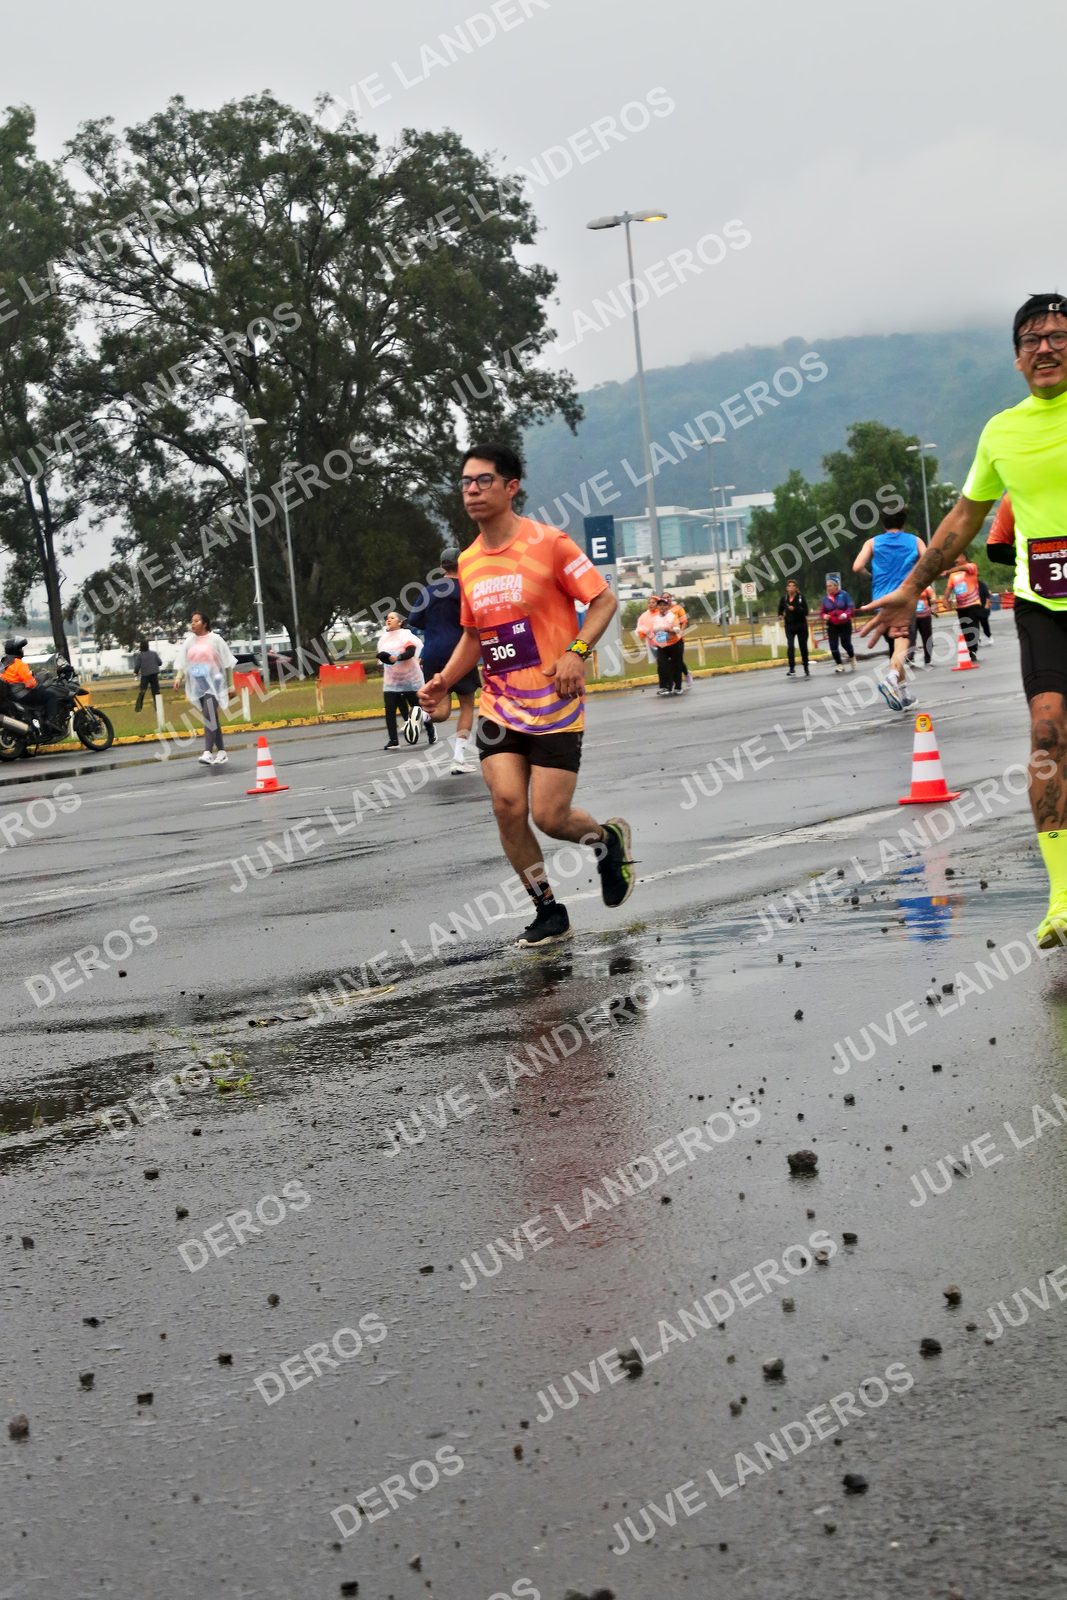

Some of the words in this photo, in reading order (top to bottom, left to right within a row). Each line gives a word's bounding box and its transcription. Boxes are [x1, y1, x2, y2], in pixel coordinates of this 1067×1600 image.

[591, 537, 608, 558] E
[473, 574, 523, 600] CARRERA
[490, 643, 516, 661] 306
